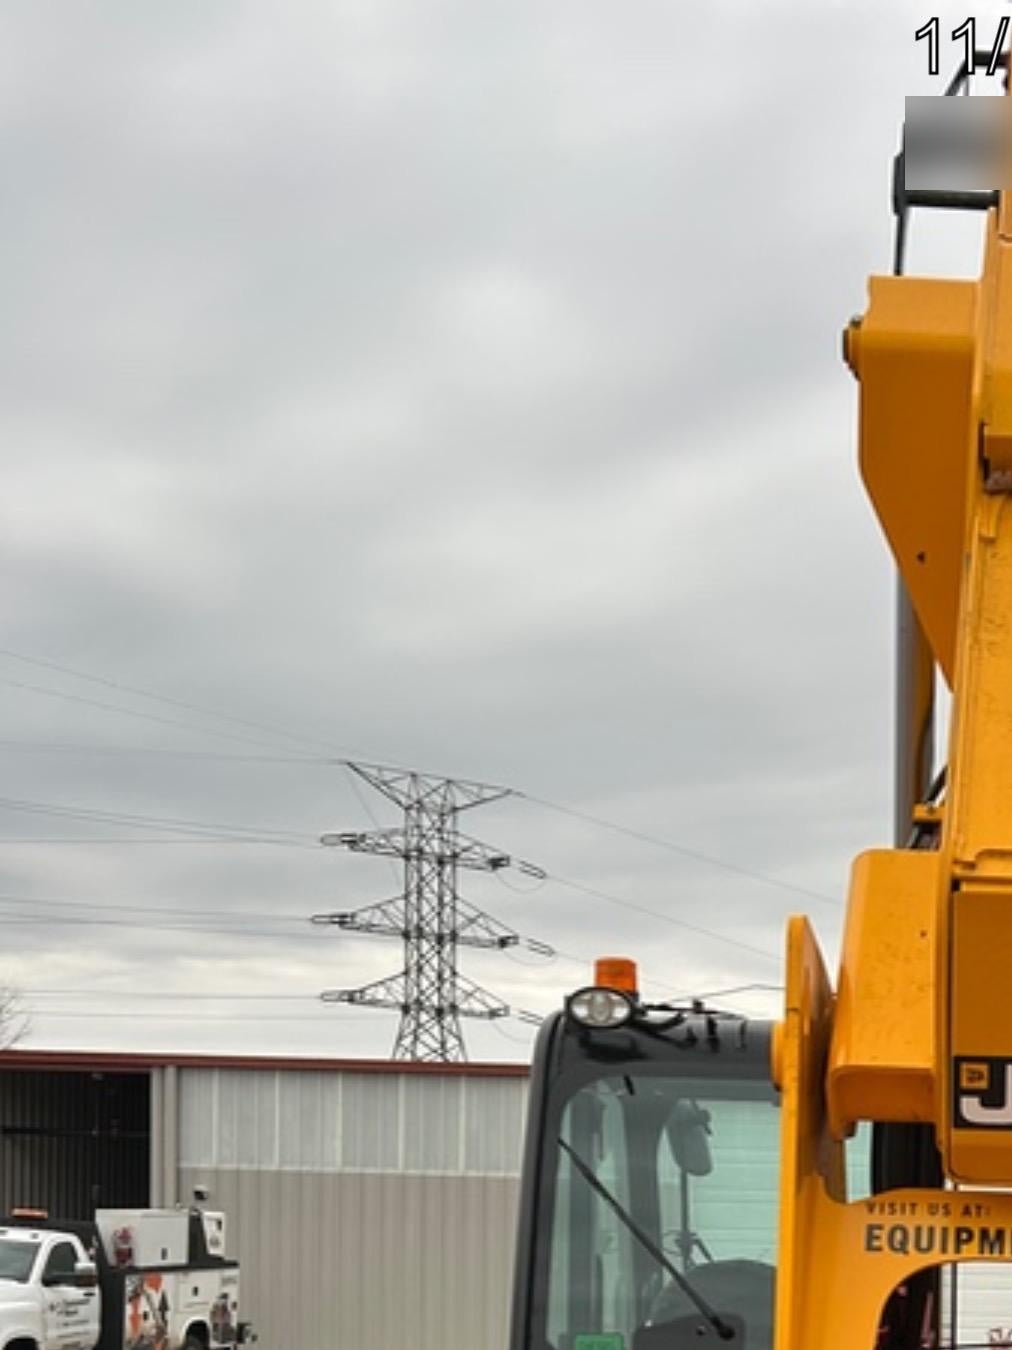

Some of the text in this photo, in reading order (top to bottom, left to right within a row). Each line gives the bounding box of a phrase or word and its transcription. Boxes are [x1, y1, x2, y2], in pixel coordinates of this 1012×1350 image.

[865, 1201, 992, 1219] VISIT US AT:
